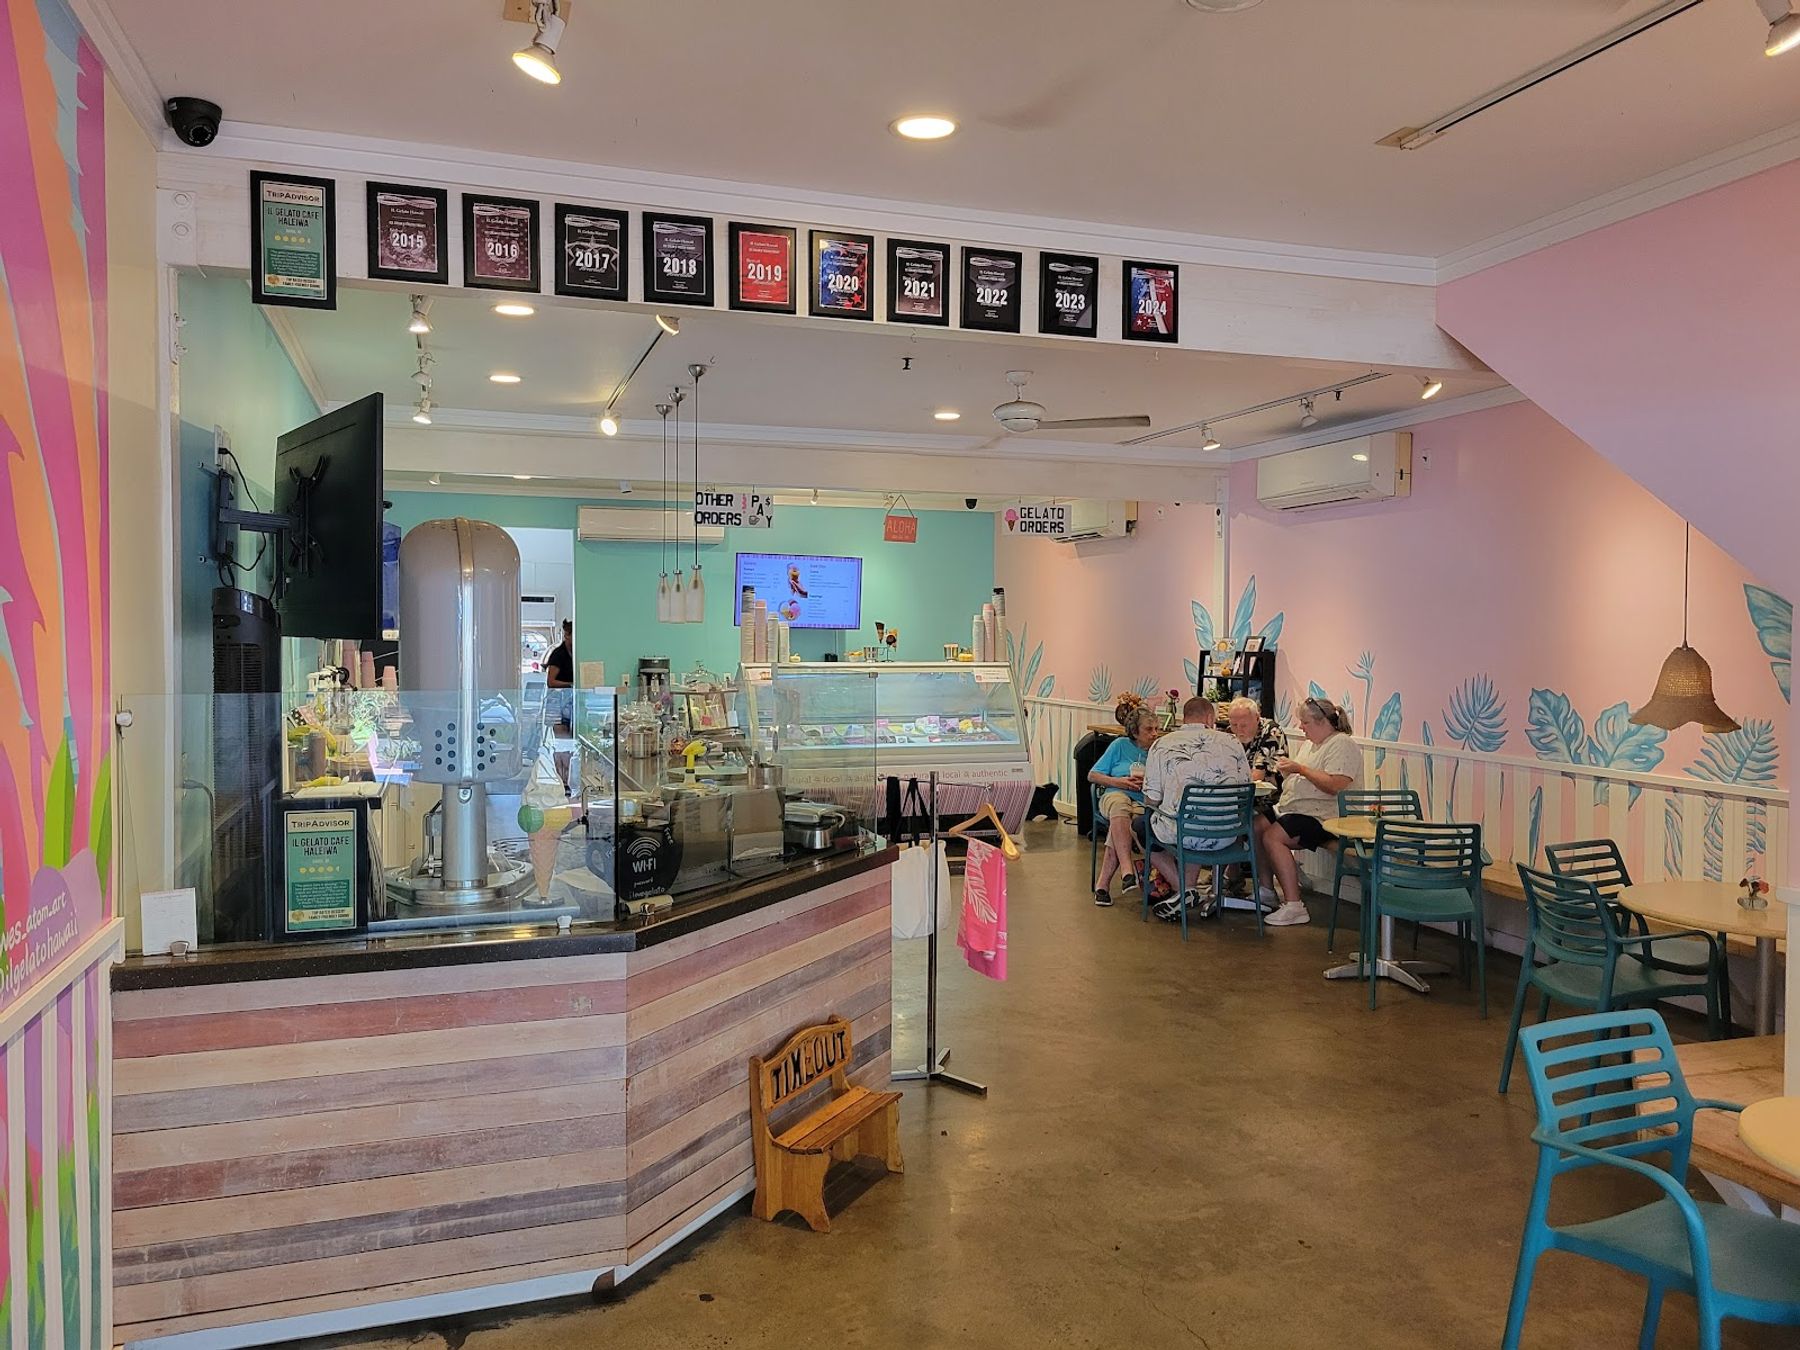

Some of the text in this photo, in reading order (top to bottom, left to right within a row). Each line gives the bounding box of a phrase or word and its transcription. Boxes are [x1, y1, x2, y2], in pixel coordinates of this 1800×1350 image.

[275, 207, 301, 218] GELATO
[302, 210, 320, 220] CAFE
[278, 217, 309, 228] HALEIWA
[392, 232, 423, 249] 2015
[487, 241, 518, 258] 2016
[575, 250, 610, 269] 2017
[663, 257, 697, 275] 2018
[747, 263, 782, 281] 2019
[827, 273, 859, 291] 2020
[904, 280, 935, 298] 2021
[976, 287, 1008, 305] 2022
[1055, 292, 1086, 310] 2023
[1138, 299, 1167, 315] 2024
[696, 492, 733, 506] OTHER
[695, 511, 742, 526] ORDERS
[1020, 507, 1065, 520] GELATO
[886, 519, 916, 535] ALOHA
[1020, 521, 1065, 533] ORDERS
[942, 770, 960, 779] local
[971, 769, 1009, 778] authentic
[292, 835, 350, 847] IL GELATO CAFE
[304, 846, 338, 856] HALEIWA
